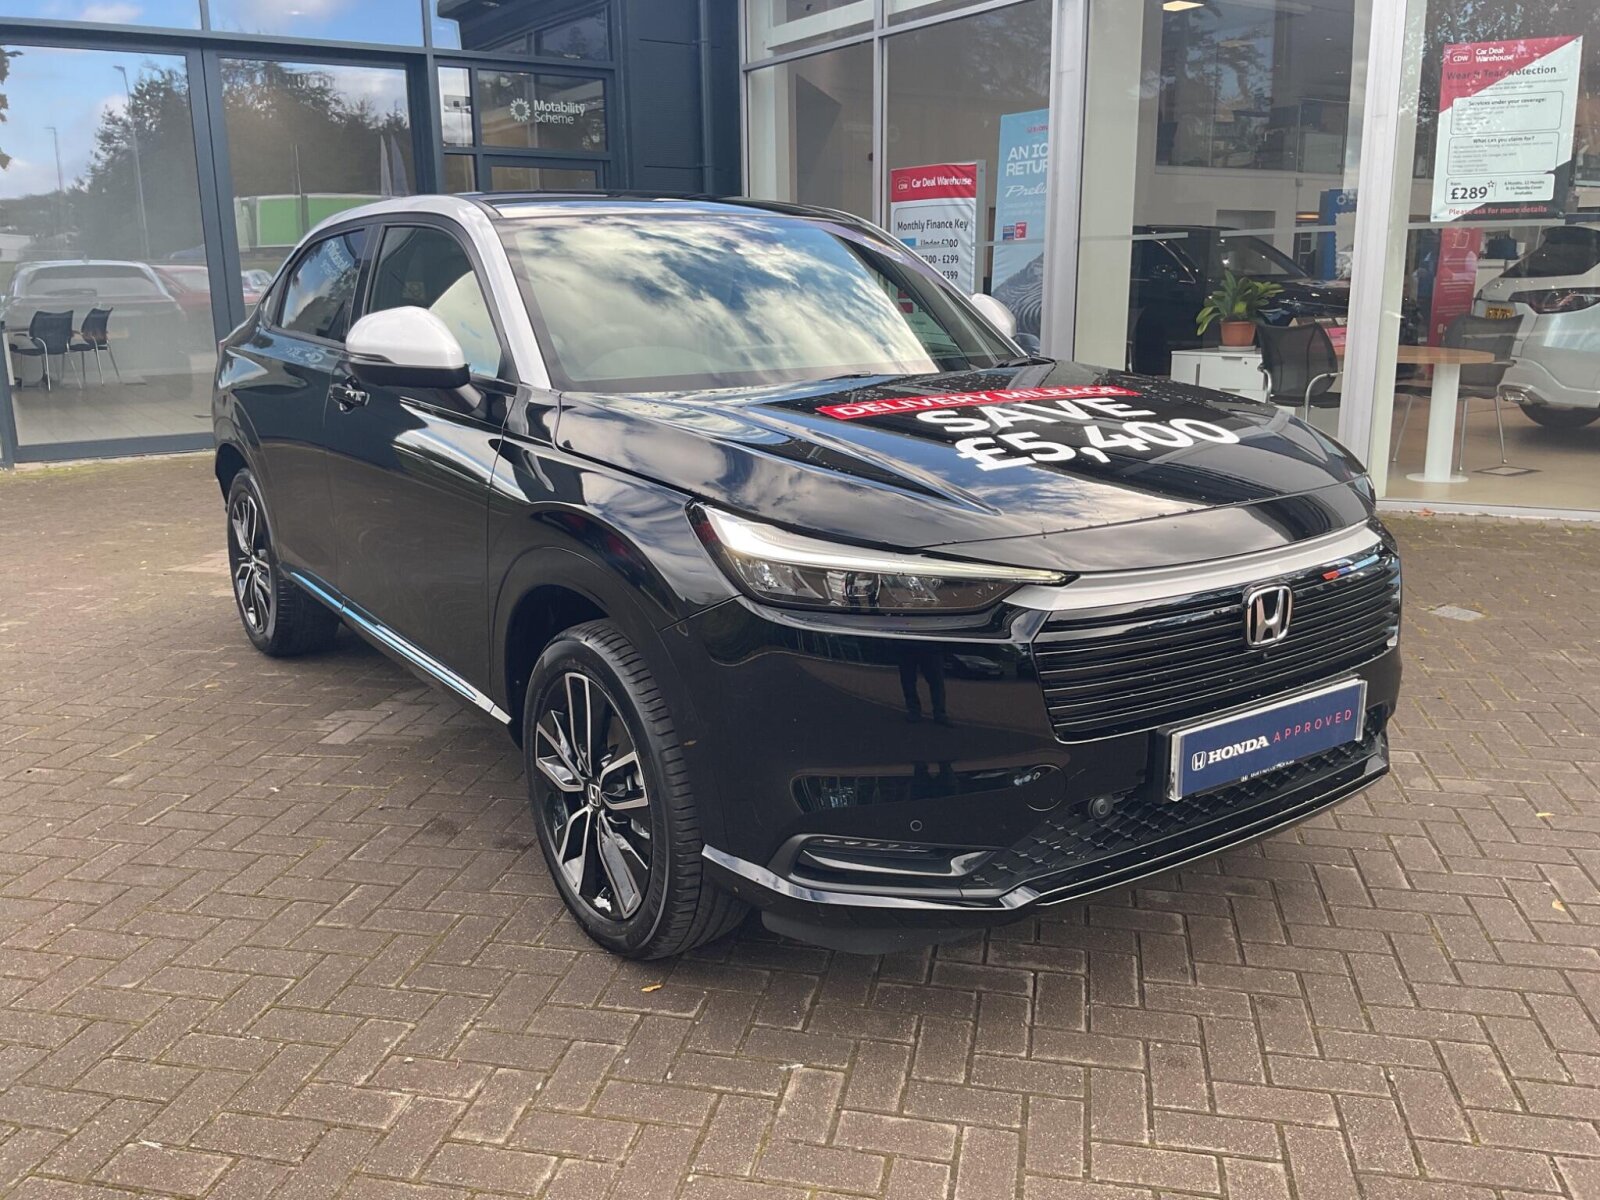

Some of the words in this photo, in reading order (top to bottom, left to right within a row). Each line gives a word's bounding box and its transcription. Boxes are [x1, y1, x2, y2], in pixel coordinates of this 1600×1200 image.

[1476, 48, 1488, 56] Car
[1489, 47, 1505, 55] Deal
[1476, 54, 1514, 63] Warehouse
[1452, 55, 1469, 63] CDW
[1447, 71, 1471, 81] Wear
[1483, 69, 1504, 78] Tear
[1507, 66, 1557, 77] Protection
[534, 99, 585, 117] Motability
[534, 111, 574, 125] Scheme
[1007, 145, 1029, 161] AN
[911, 179, 920, 188] Car
[922, 177, 936, 187] Deal
[937, 176, 973, 186] Warehouse
[1450, 186, 1488, 200] £289
[1520, 205, 1548, 213] details
[897, 220, 925, 232] Monthly
[926, 219, 953, 229] Finance
[954, 218, 969, 231] Key
[921, 239, 940, 247] Under
[942, 255, 959, 264] £299
[832, 393, 990, 417] DELIVERY
[1002, 386, 1127, 401] MILEAGE
[916, 397, 1157, 433] SAVE
[955, 418, 1240, 472] £5,400
[1208, 735, 1270, 764] HONDA
[1273, 709, 1352, 743] APPROVED
